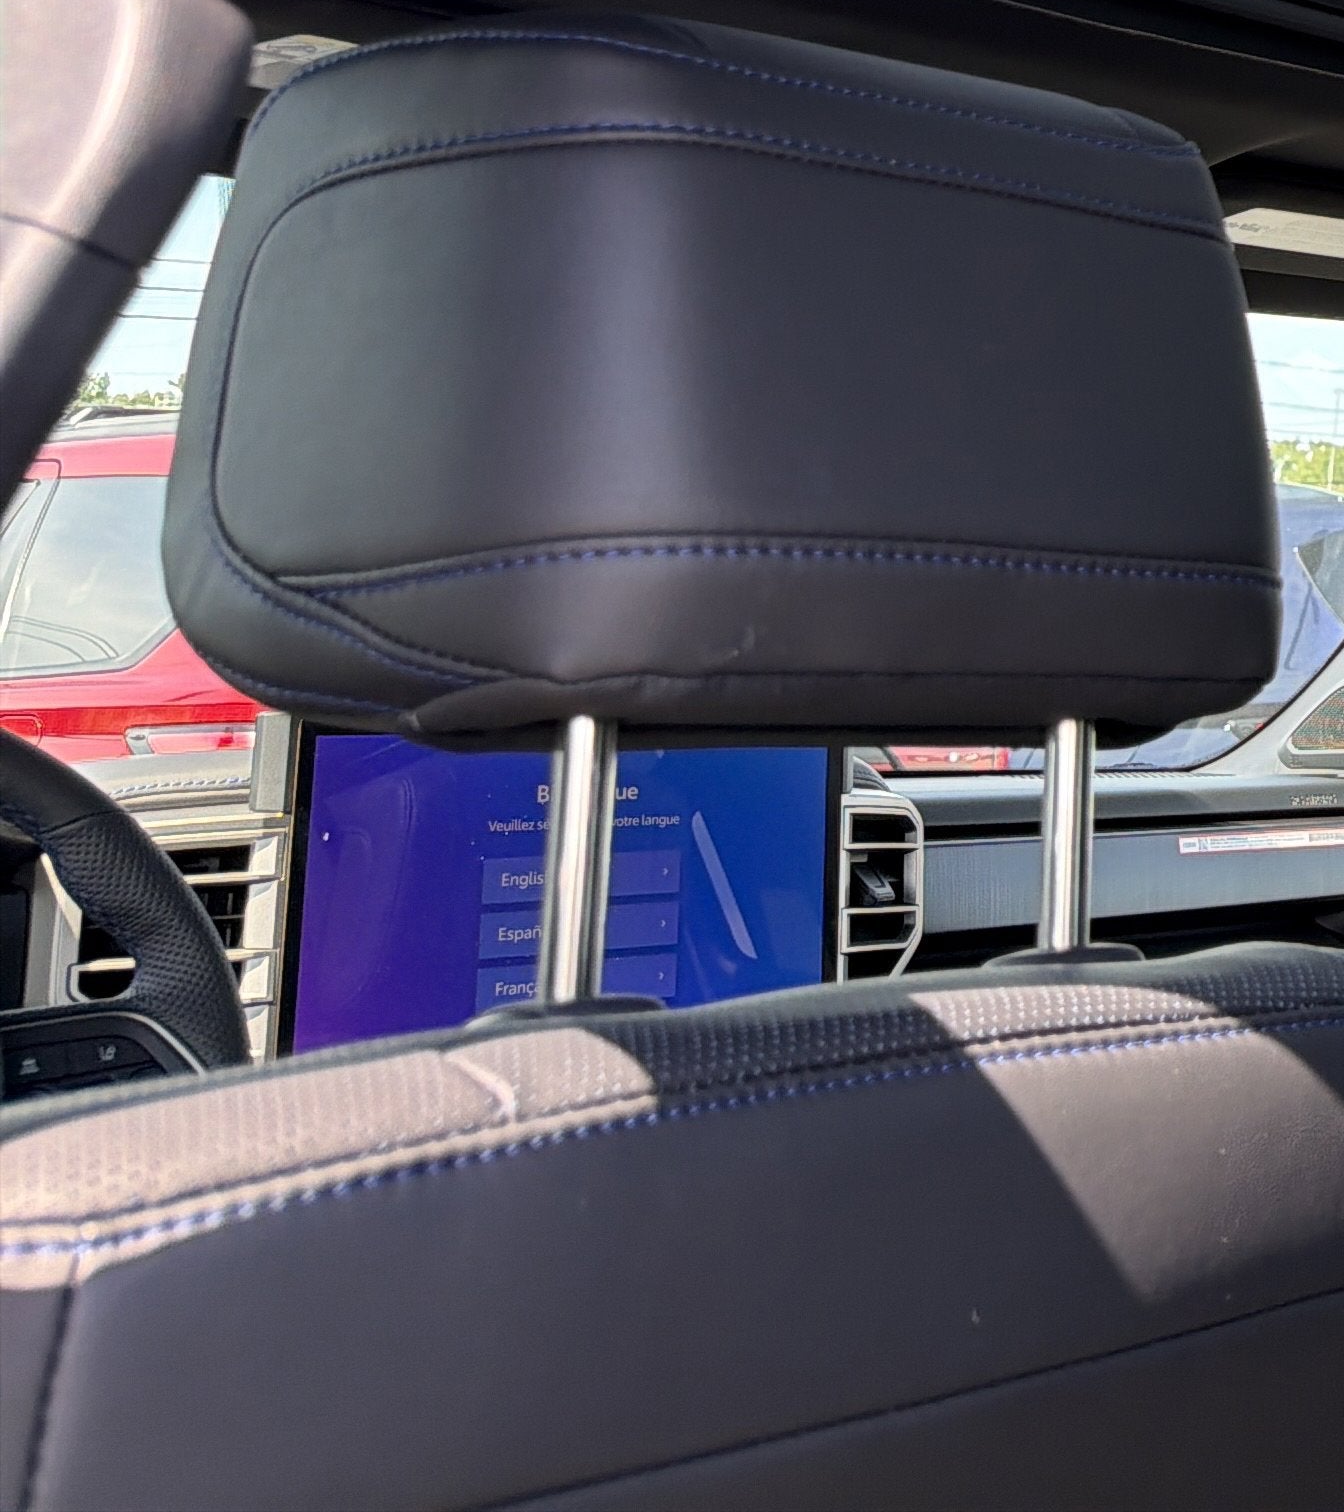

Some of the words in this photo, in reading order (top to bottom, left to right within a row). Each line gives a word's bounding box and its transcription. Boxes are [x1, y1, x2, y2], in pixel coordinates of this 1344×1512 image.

[488, 819, 534, 832] Veuillez
[641, 814, 681, 829] langue
[501, 871, 545, 889] Englis
[498, 924, 542, 943] Españ
[495, 981, 538, 997] Franç
